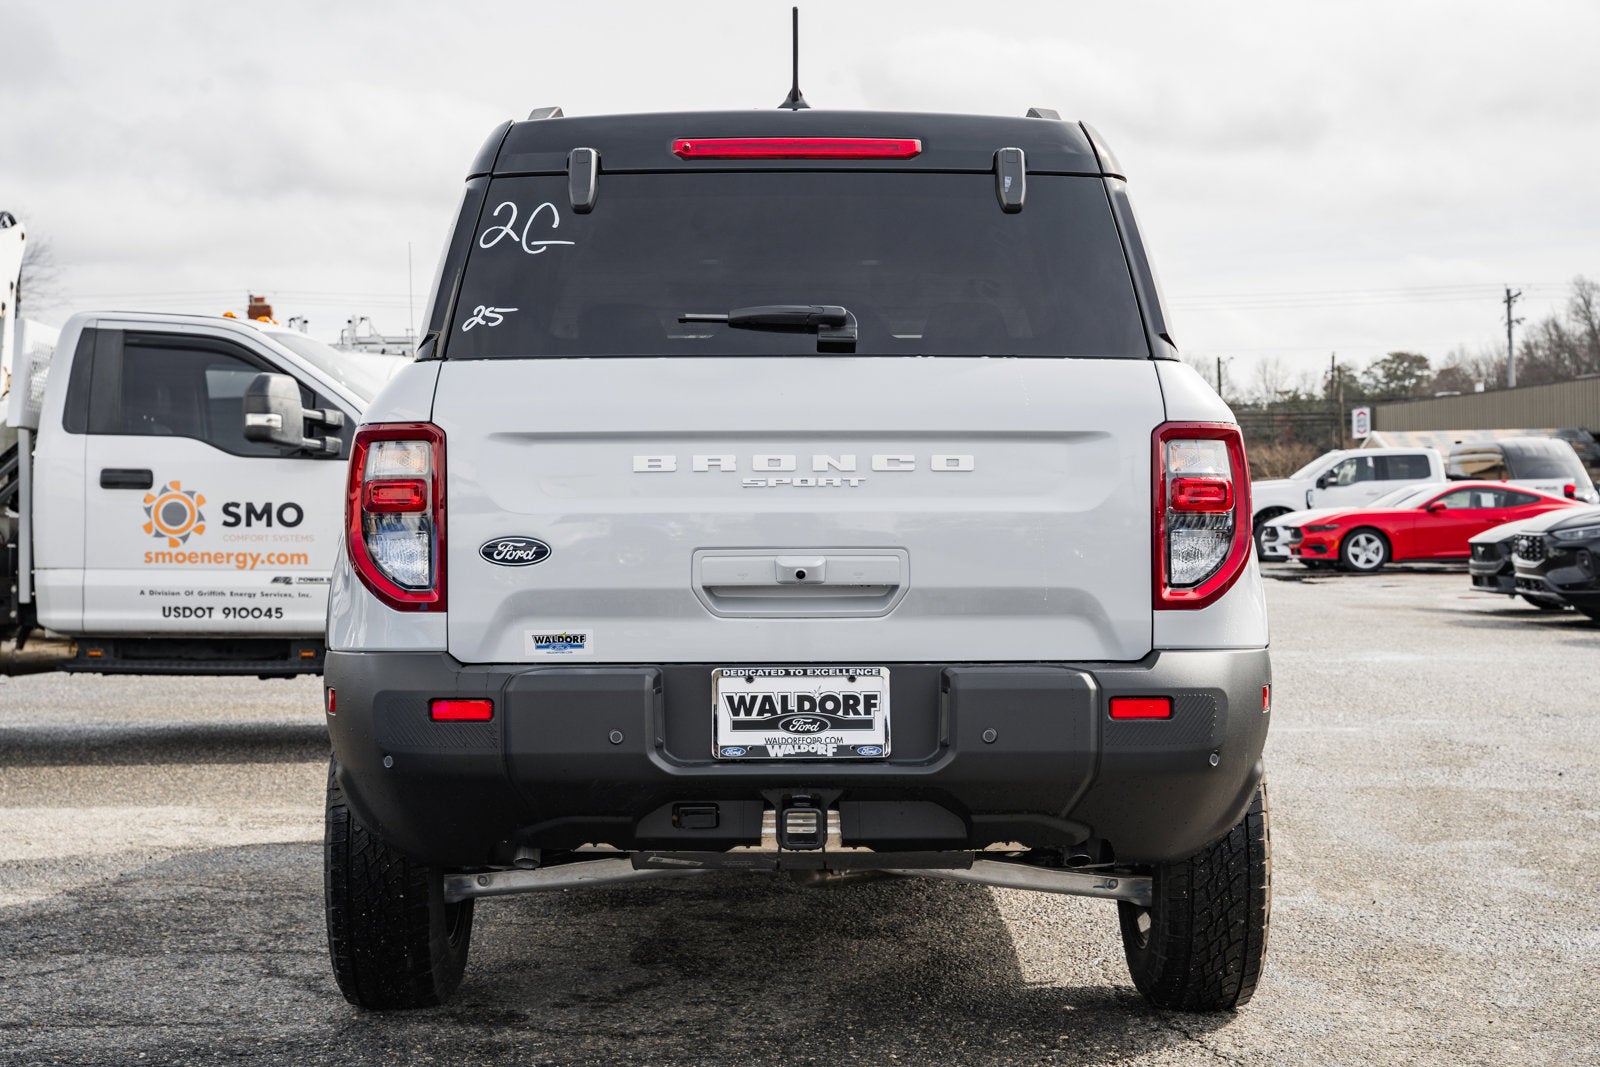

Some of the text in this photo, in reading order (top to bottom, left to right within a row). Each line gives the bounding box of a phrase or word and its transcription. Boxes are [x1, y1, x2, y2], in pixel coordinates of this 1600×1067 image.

[462, 305, 519, 332] 25
[632, 454, 976, 472] BRONCO
[742, 477, 867, 489] SPORT
[222, 502, 304, 528] SMO
[222, 534, 315, 542] COMFORT SYSTEMS
[493, 541, 537, 560] Ford
[143, 551, 309, 570] smoenergy.com
[230, 591, 257, 599] Energy
[260, 591, 295, 599] Services,
[162, 606, 284, 619] USDOT 910045
[532, 634, 586, 645] WALDORF
[808, 668, 880, 676] EXCELLENCE
[722, 691, 881, 718] WALDORF
[789, 718, 820, 732] Ford
[764, 736, 844, 745] WALDORFFORD.COM
[765, 744, 838, 758] WALDORF
